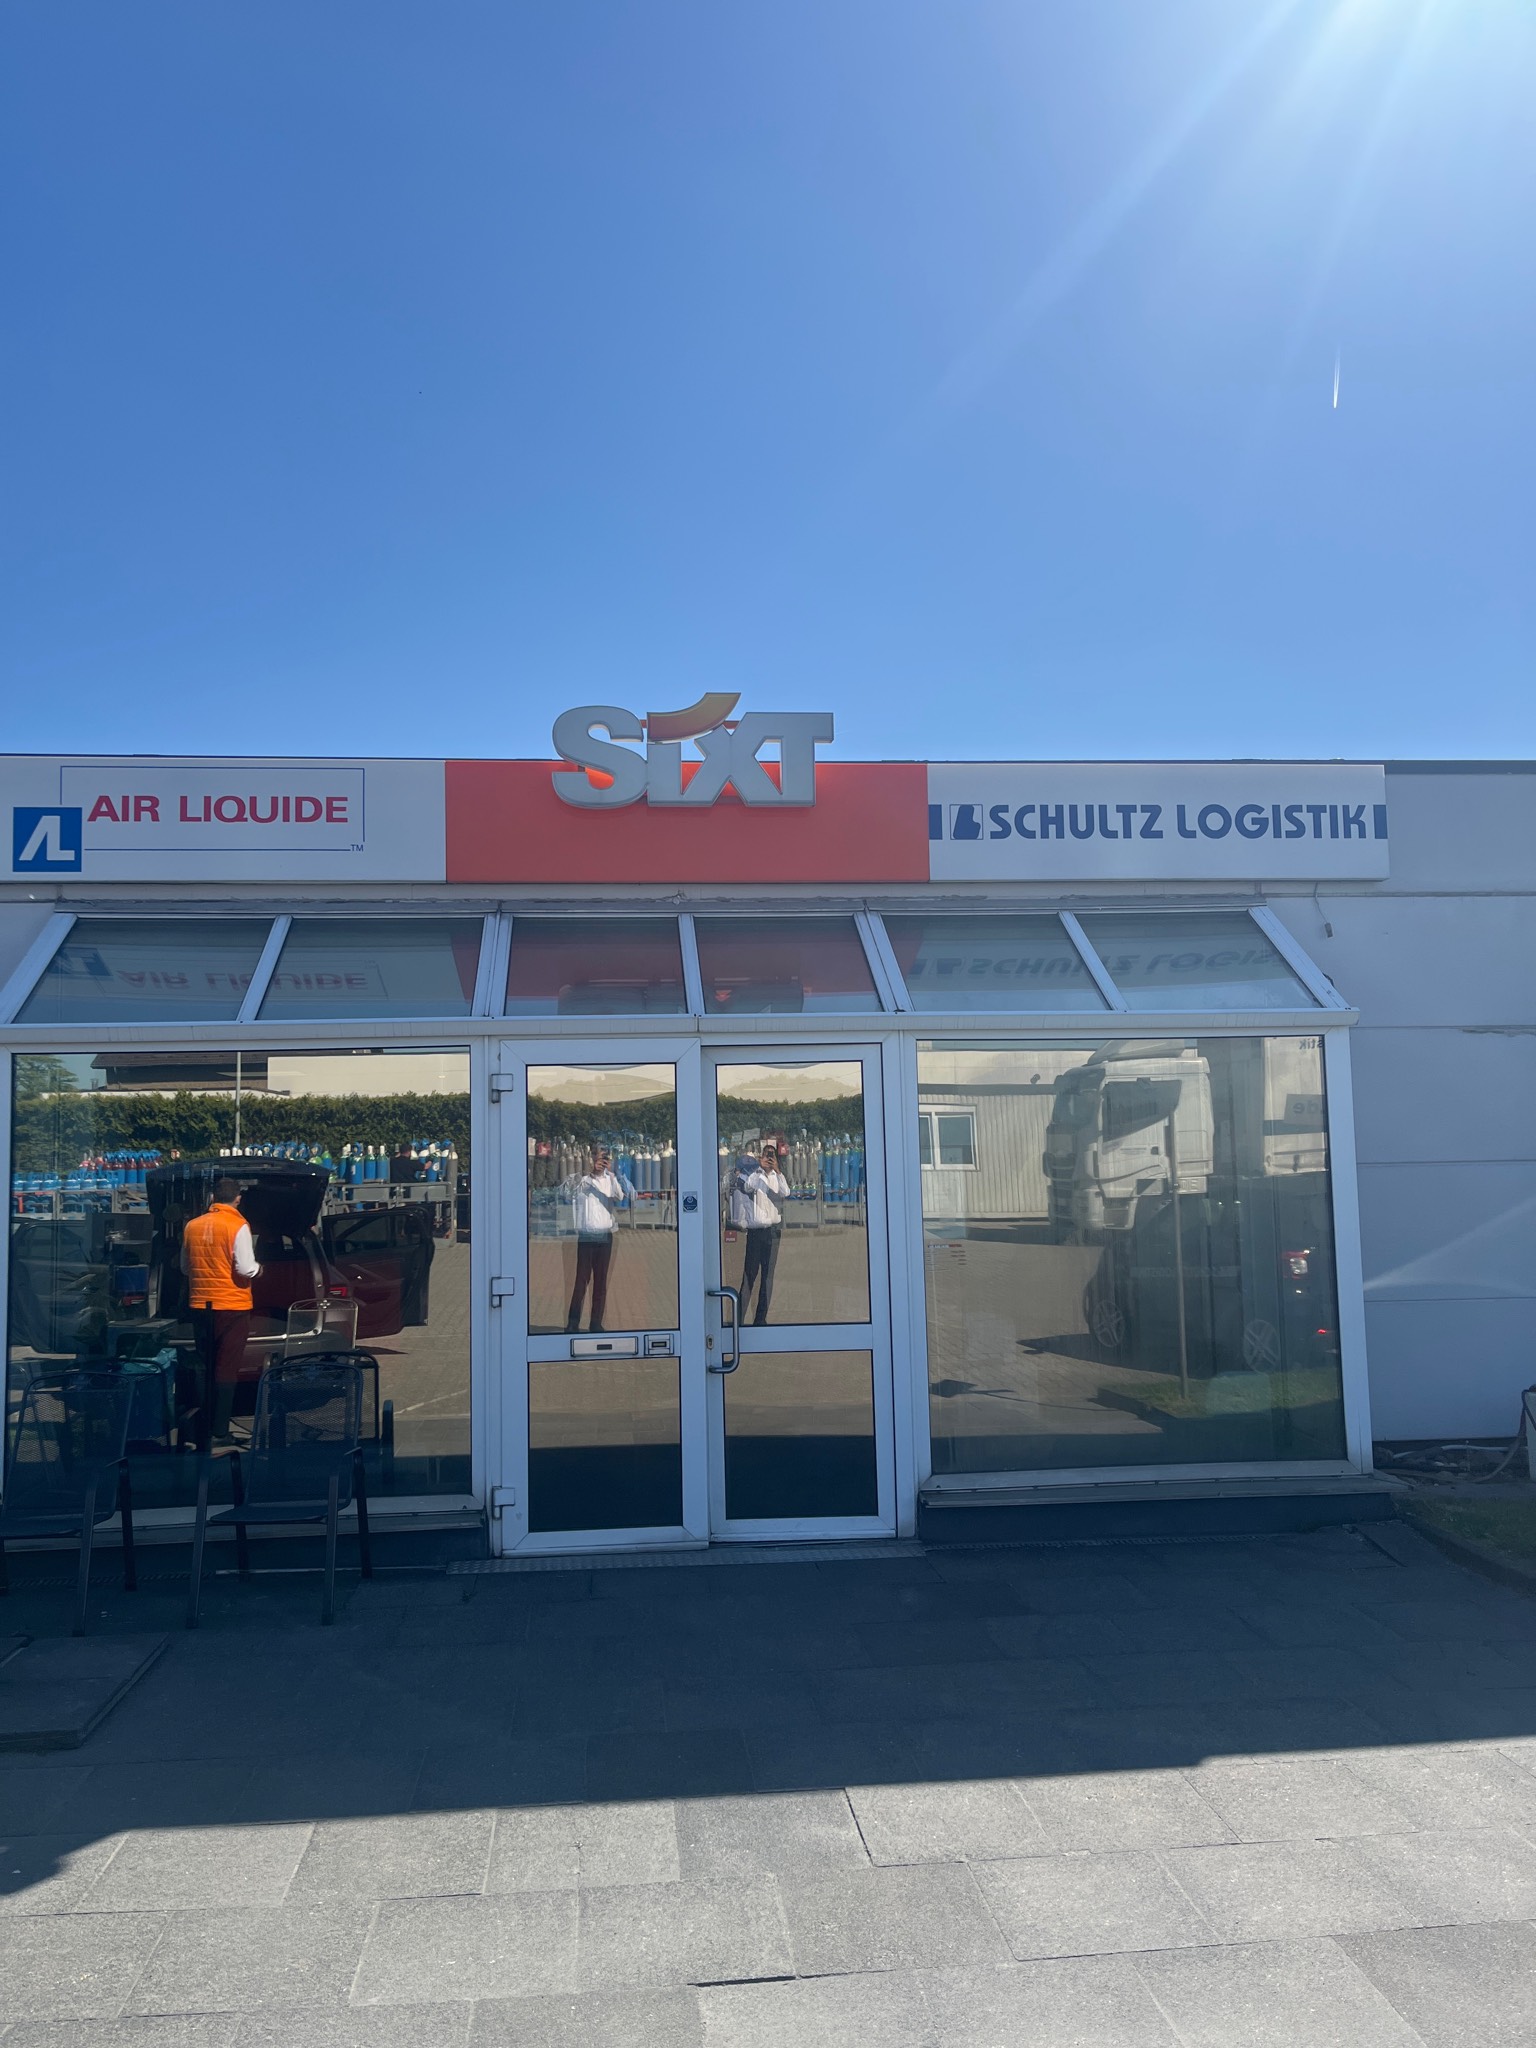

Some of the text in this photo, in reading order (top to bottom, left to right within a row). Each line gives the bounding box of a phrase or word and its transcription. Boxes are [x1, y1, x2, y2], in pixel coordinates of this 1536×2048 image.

[87, 795, 349, 823] AIR LIQUIDE
[989, 803, 1367, 840] SCHULTZ LOGISTIK
